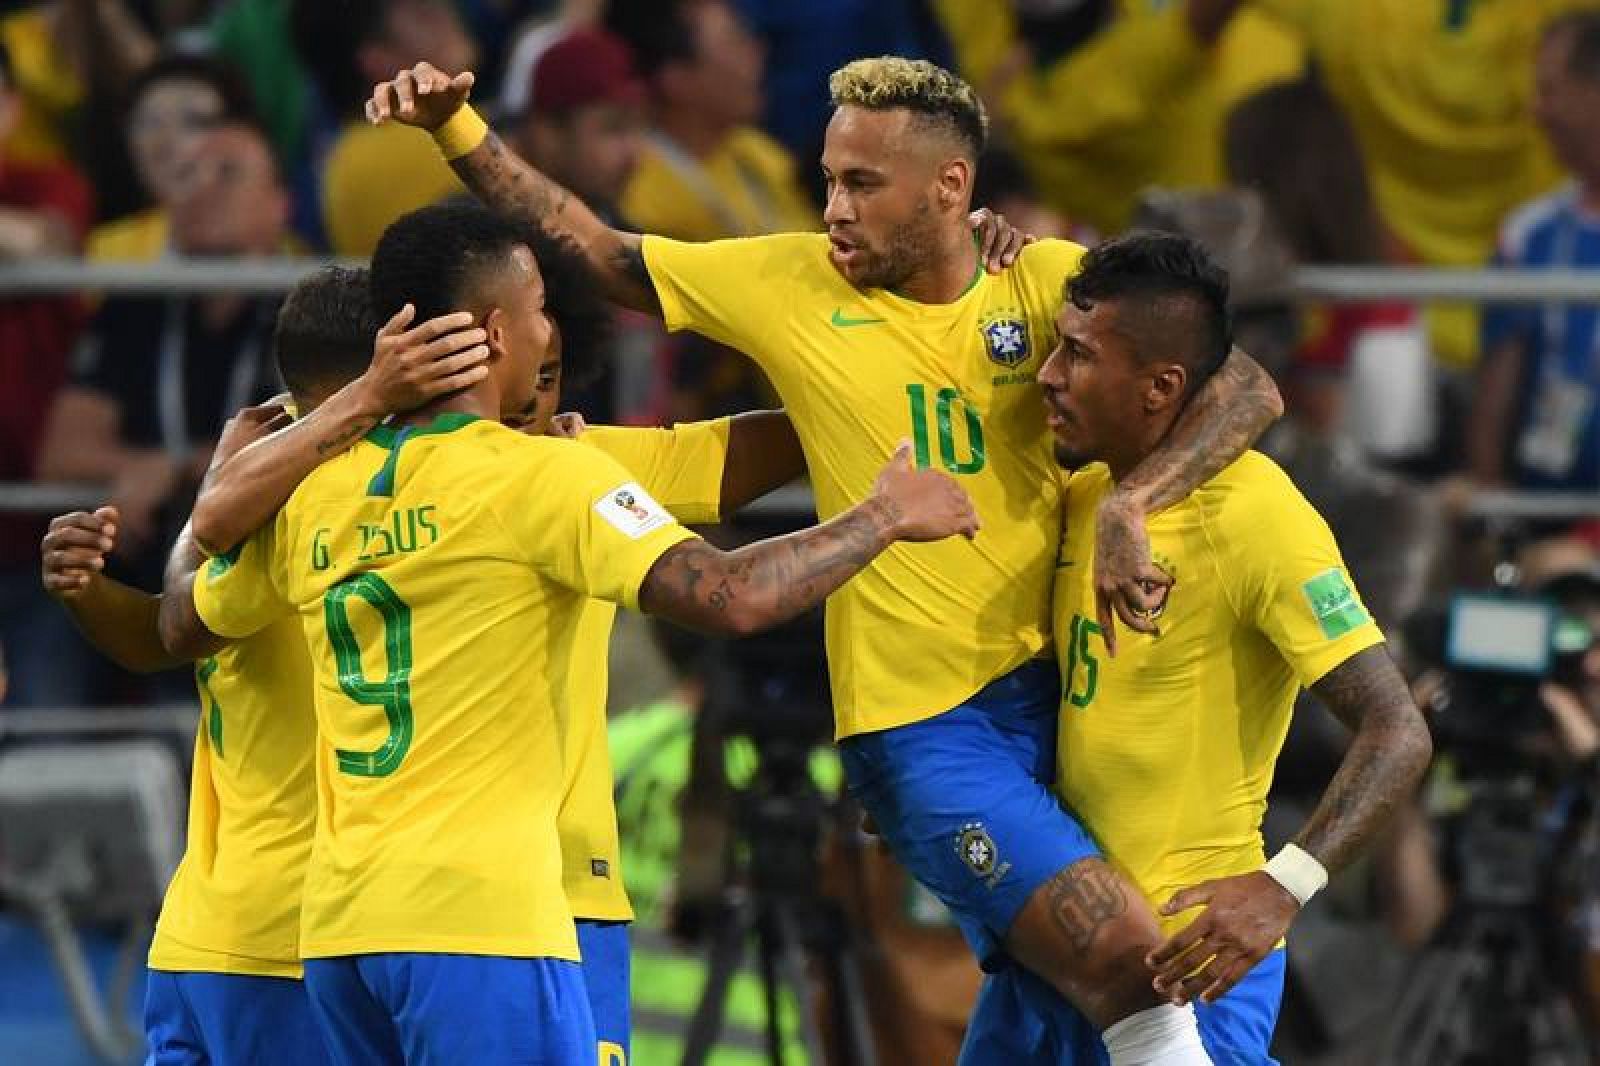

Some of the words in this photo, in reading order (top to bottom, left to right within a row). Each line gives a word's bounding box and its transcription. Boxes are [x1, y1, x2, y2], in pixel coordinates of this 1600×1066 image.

[906, 383, 985, 475] 10
[324, 570, 415, 778] 9
[1063, 613, 1101, 708] 15
